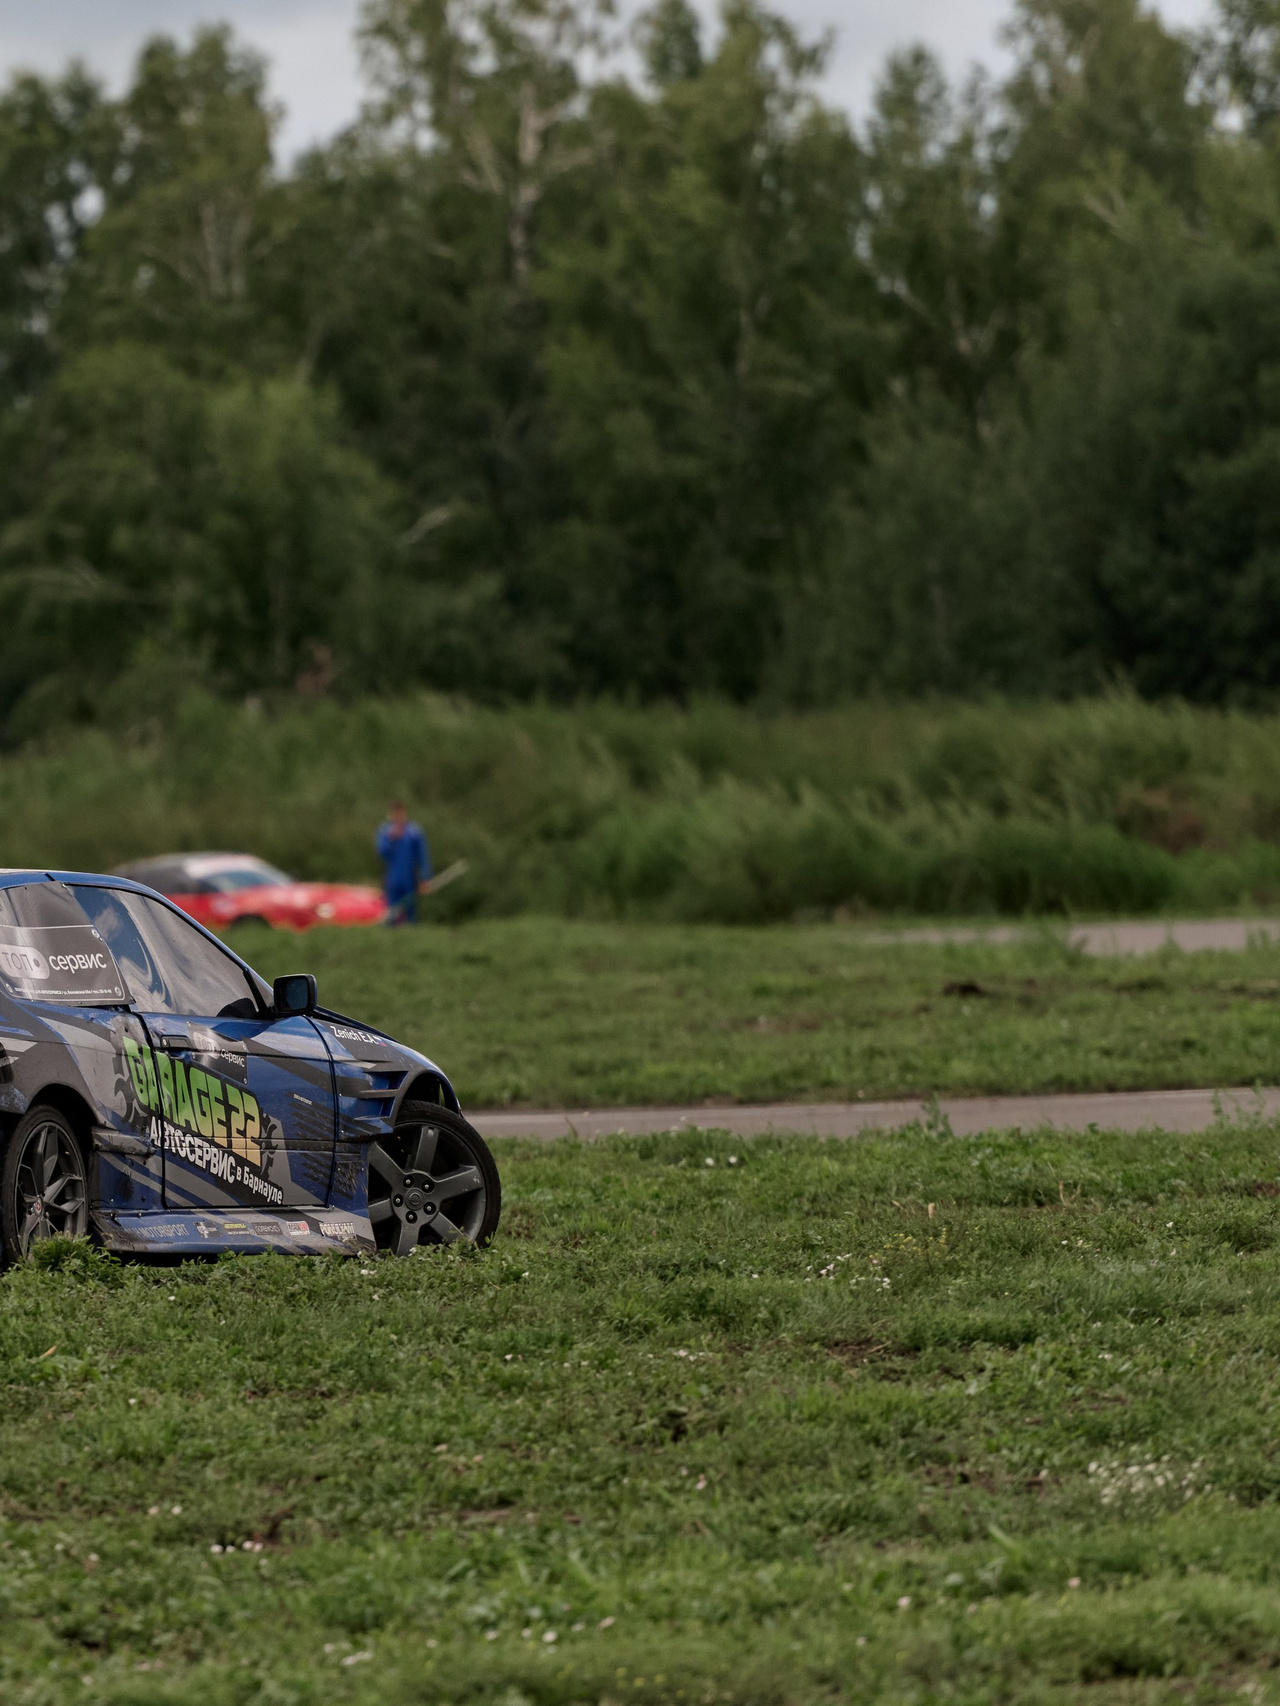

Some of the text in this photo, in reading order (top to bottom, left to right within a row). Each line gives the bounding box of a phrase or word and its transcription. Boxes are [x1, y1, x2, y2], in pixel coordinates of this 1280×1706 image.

[1, 951, 107, 974] ТОП сервис
[329, 1025, 361, 1041] Zenich
[220, 1048, 245, 1068] сервис
[123, 1036, 261, 1167] GARAGE 22
[150, 1116, 283, 1205] АВТОСЕРВИС в Барнауле
